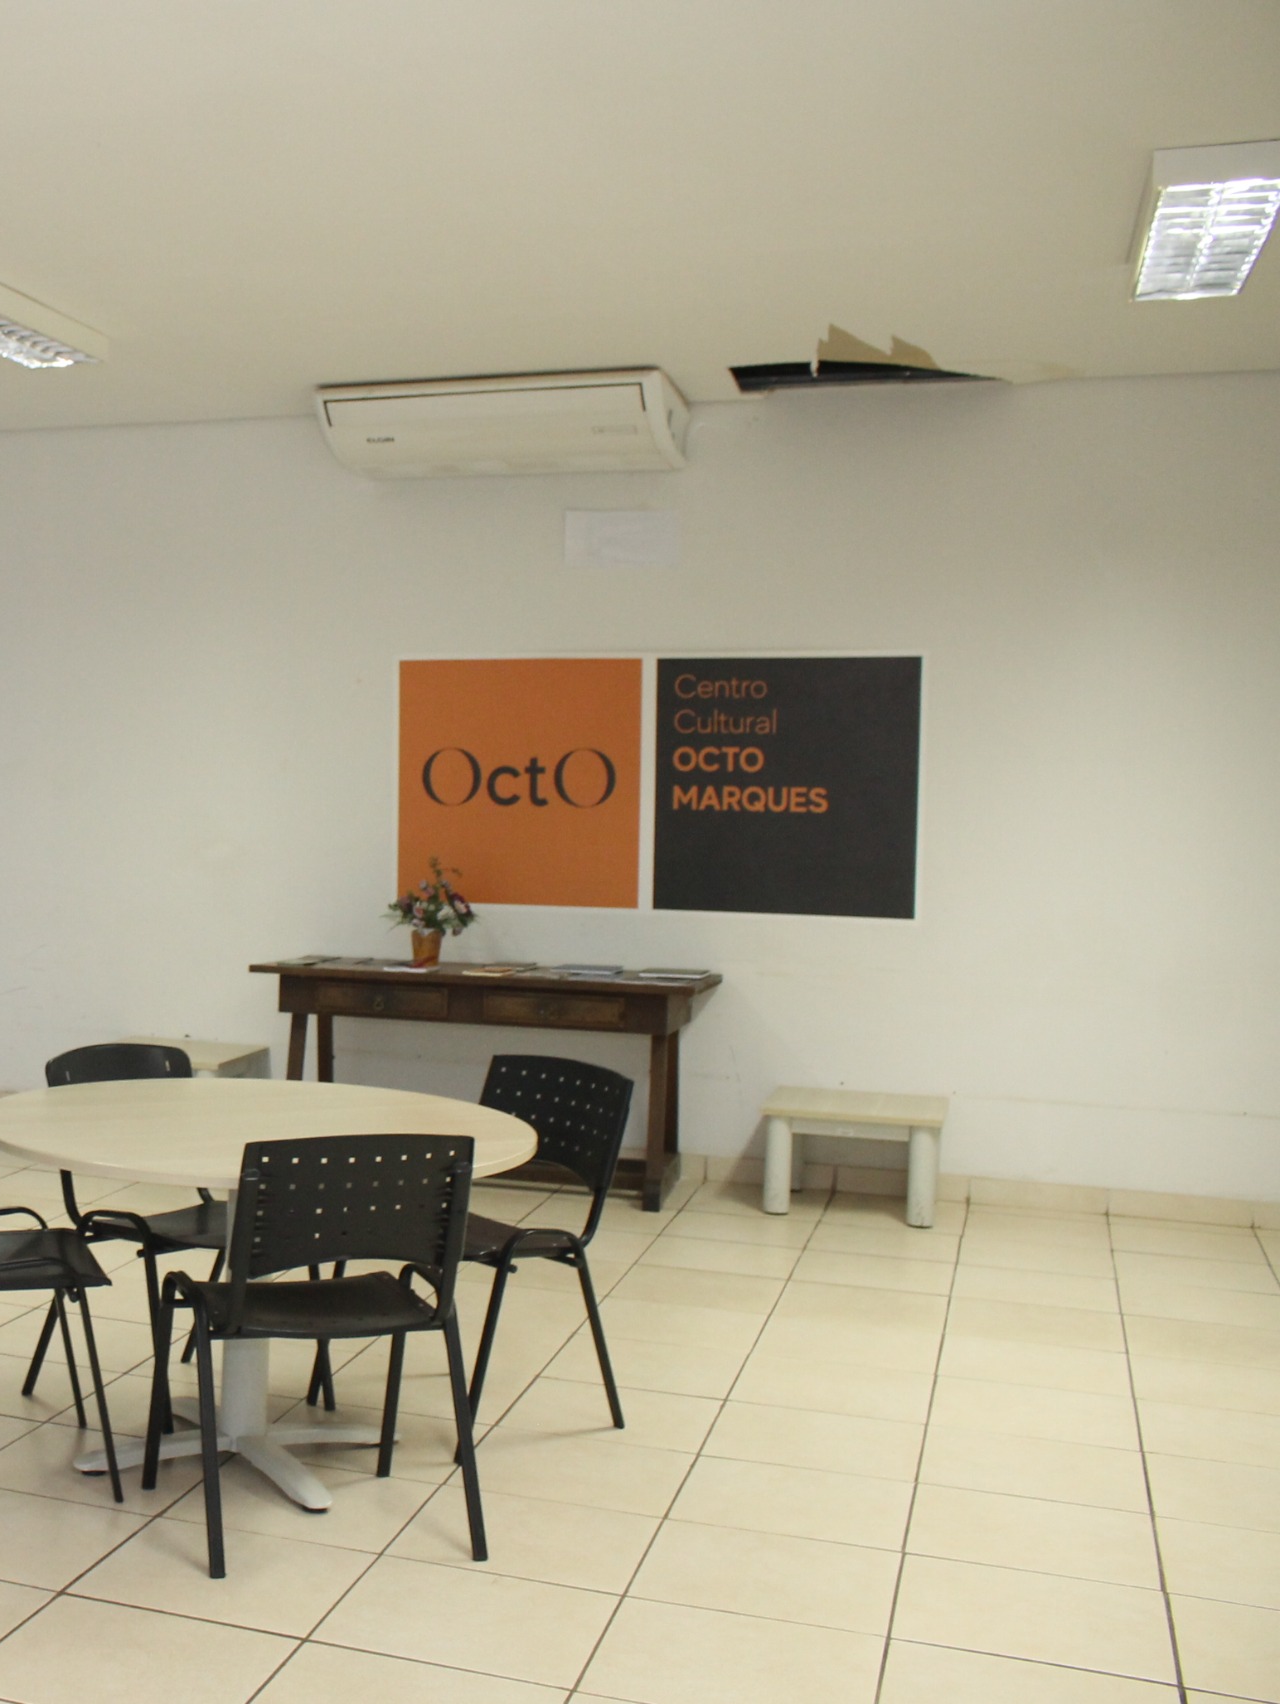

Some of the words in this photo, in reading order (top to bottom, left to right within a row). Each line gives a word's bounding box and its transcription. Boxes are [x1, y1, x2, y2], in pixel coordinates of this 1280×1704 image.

[674, 673, 768, 699] Centro
[673, 708, 778, 735] Cultural
[672, 745, 766, 773] OCTO
[421, 747, 617, 808] OctO
[672, 784, 830, 814] MARQUES
